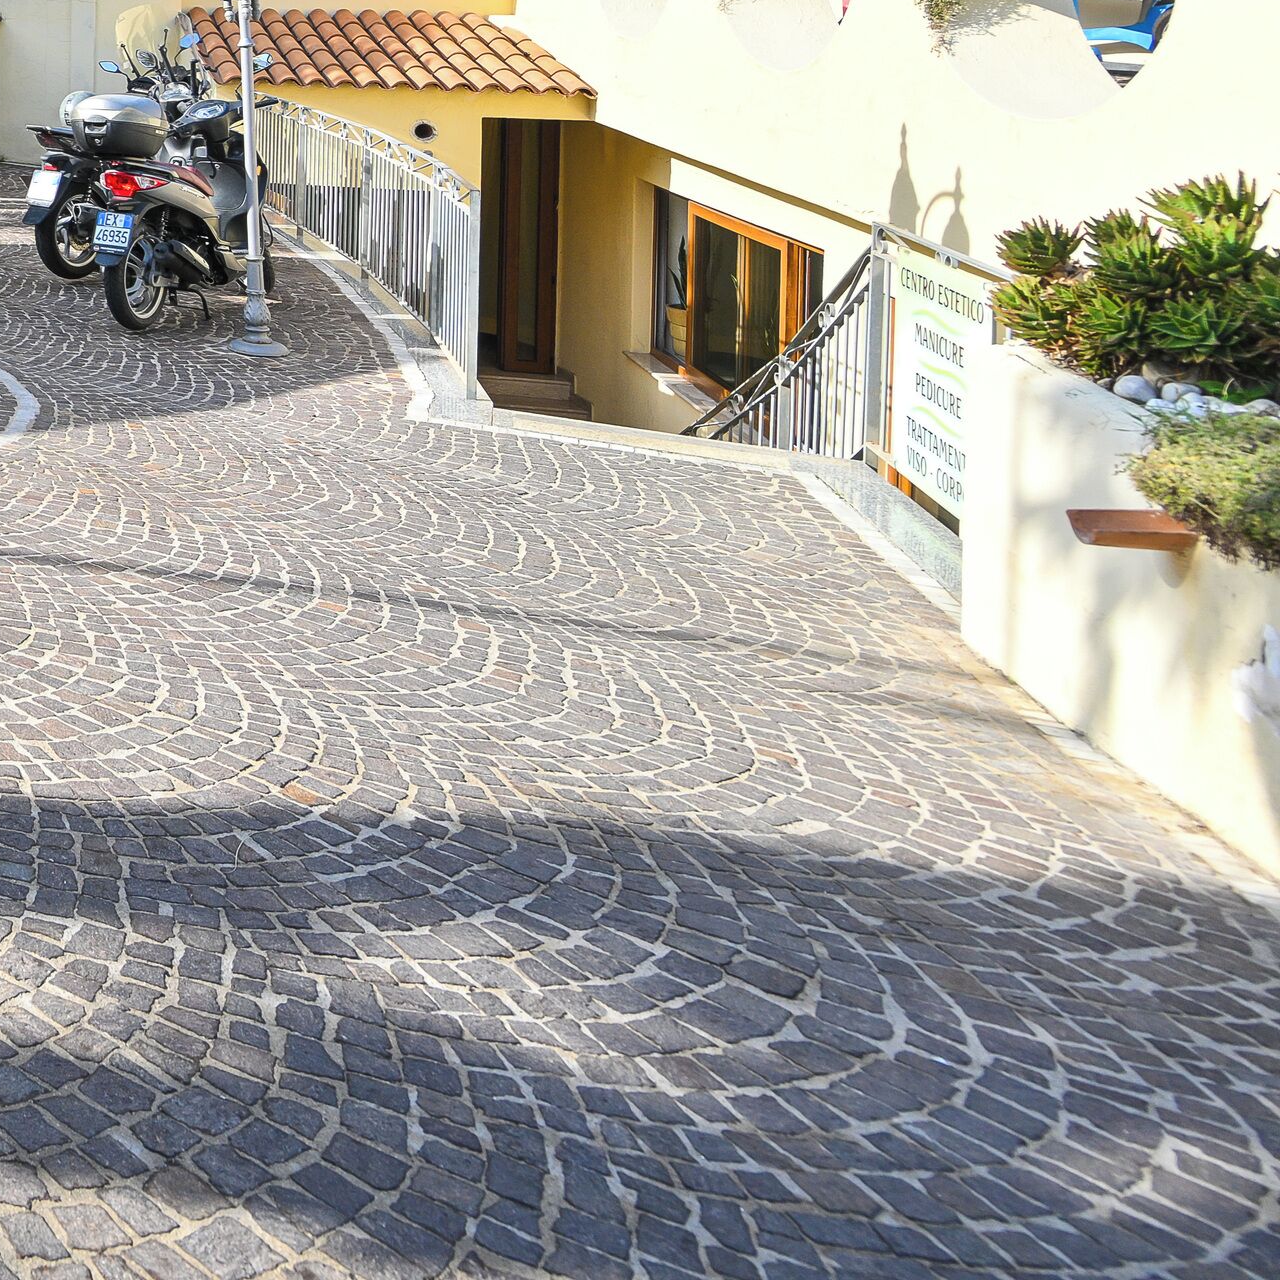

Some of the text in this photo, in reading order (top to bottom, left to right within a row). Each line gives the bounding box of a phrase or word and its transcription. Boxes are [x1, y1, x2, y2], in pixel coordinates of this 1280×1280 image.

[96, 229, 128, 244] 46935
[105, 213, 119, 227] EX
[901, 267, 984, 324] CENTRO ESTETICO
[914, 322, 964, 368] MANICURE
[915, 372, 962, 420] PEDICURE
[907, 445, 927, 476] VISO
[936, 468, 965, 502] CORP
